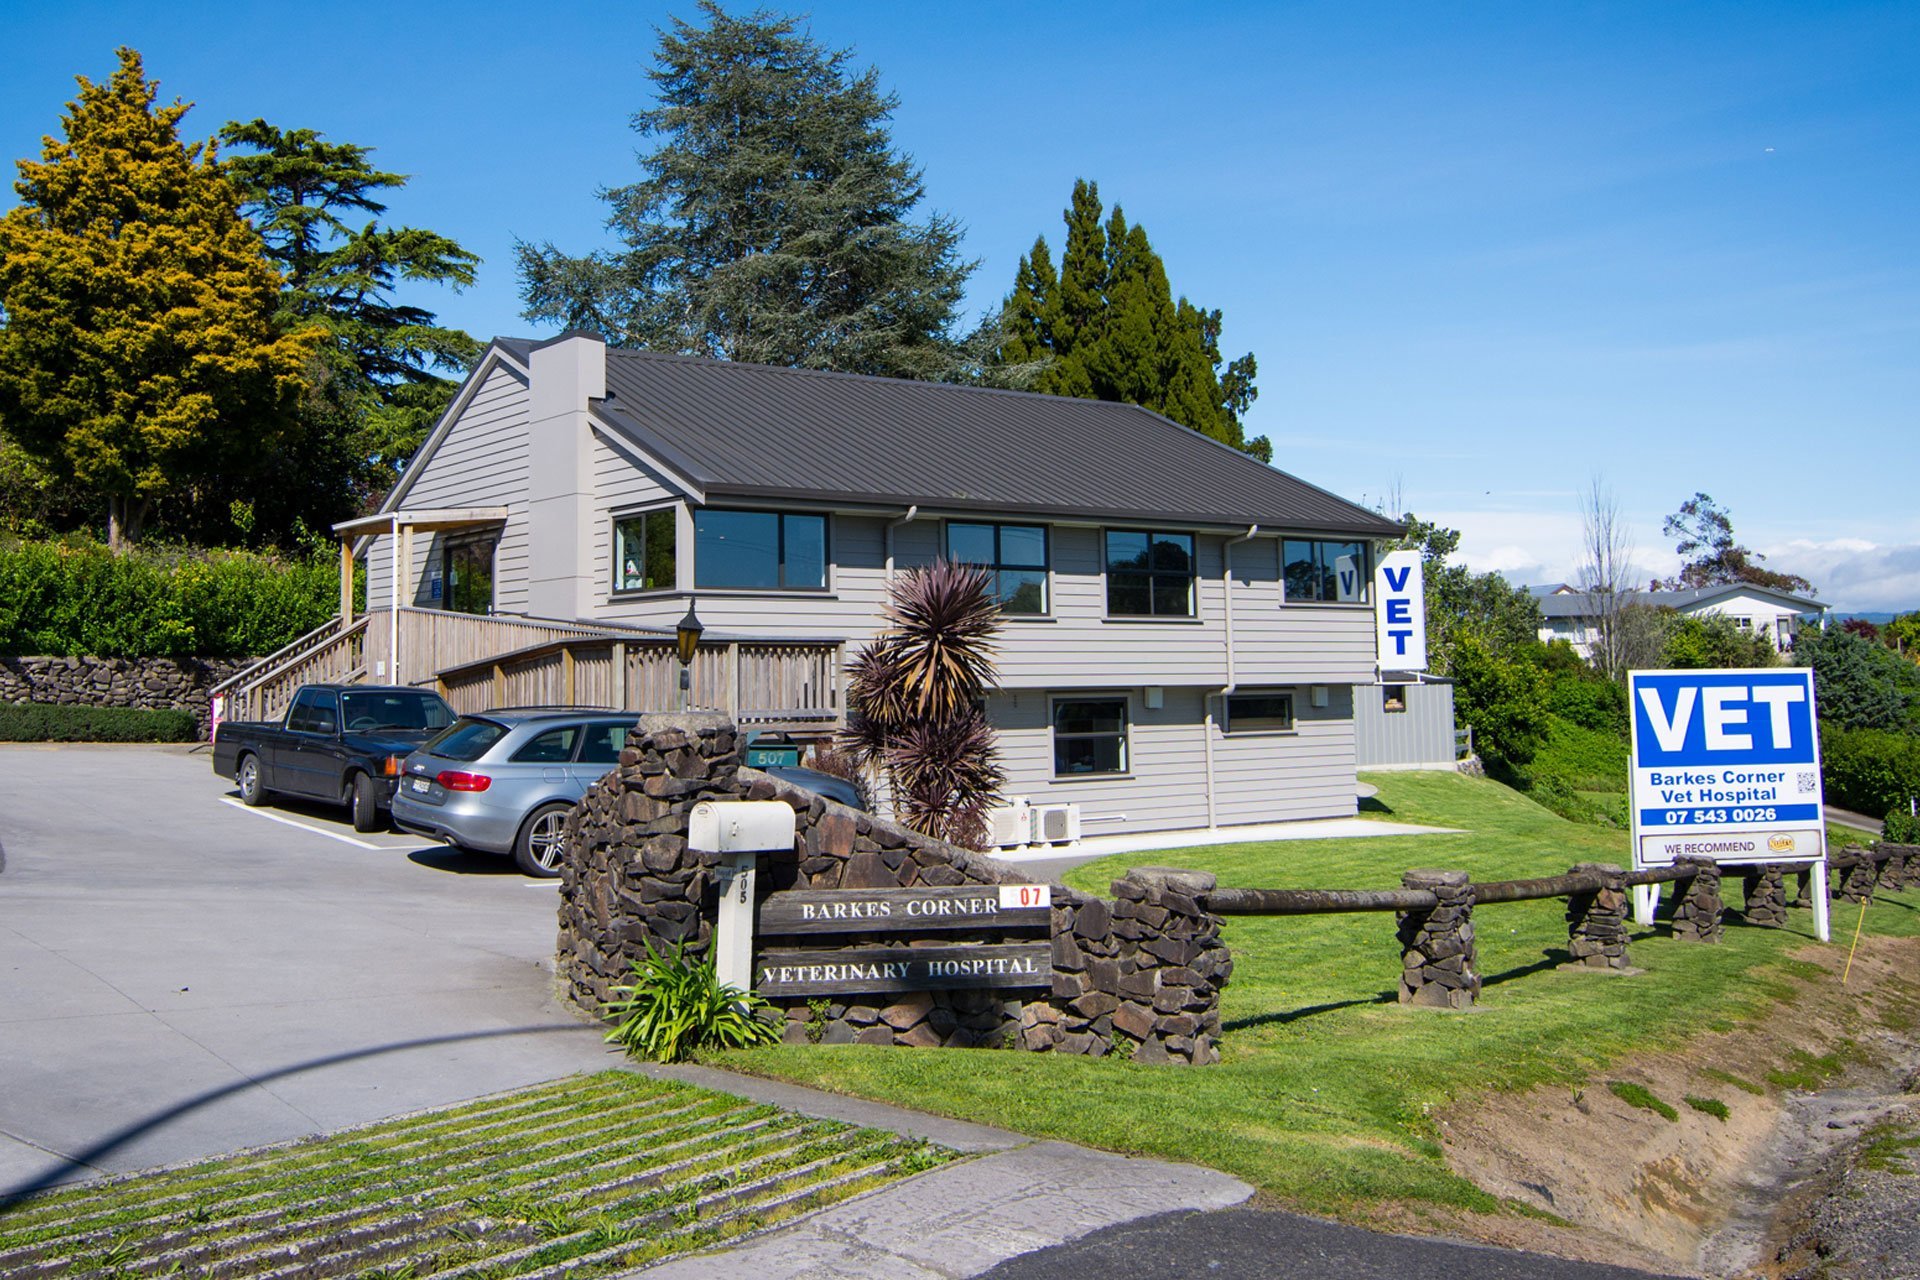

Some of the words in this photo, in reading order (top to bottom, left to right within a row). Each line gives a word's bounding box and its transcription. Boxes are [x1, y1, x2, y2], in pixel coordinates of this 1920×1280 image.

[1383, 567, 1413, 655] VET
[1638, 685, 1805, 752] VET
[758, 752, 784, 765] 507
[1650, 772, 1716, 785] Barkes
[1723, 770, 1785, 784] Corner
[1661, 790, 1693, 803] Vet
[1700, 787, 1776, 804] Hospital
[1665, 811, 1688, 824] 07
[1694, 809, 1727, 823] 543
[1732, 808, 1777, 822] 0026
[1664, 843, 1681, 854] WE
[1684, 841, 1756, 854] RECOMMEND
[740, 865, 748, 904] 505
[802, 901, 891, 920] BARKES
[906, 898, 999, 917] CORNER
[763, 962, 912, 983] VETERINARY
[928, 957, 1038, 977] HOSPITAL
